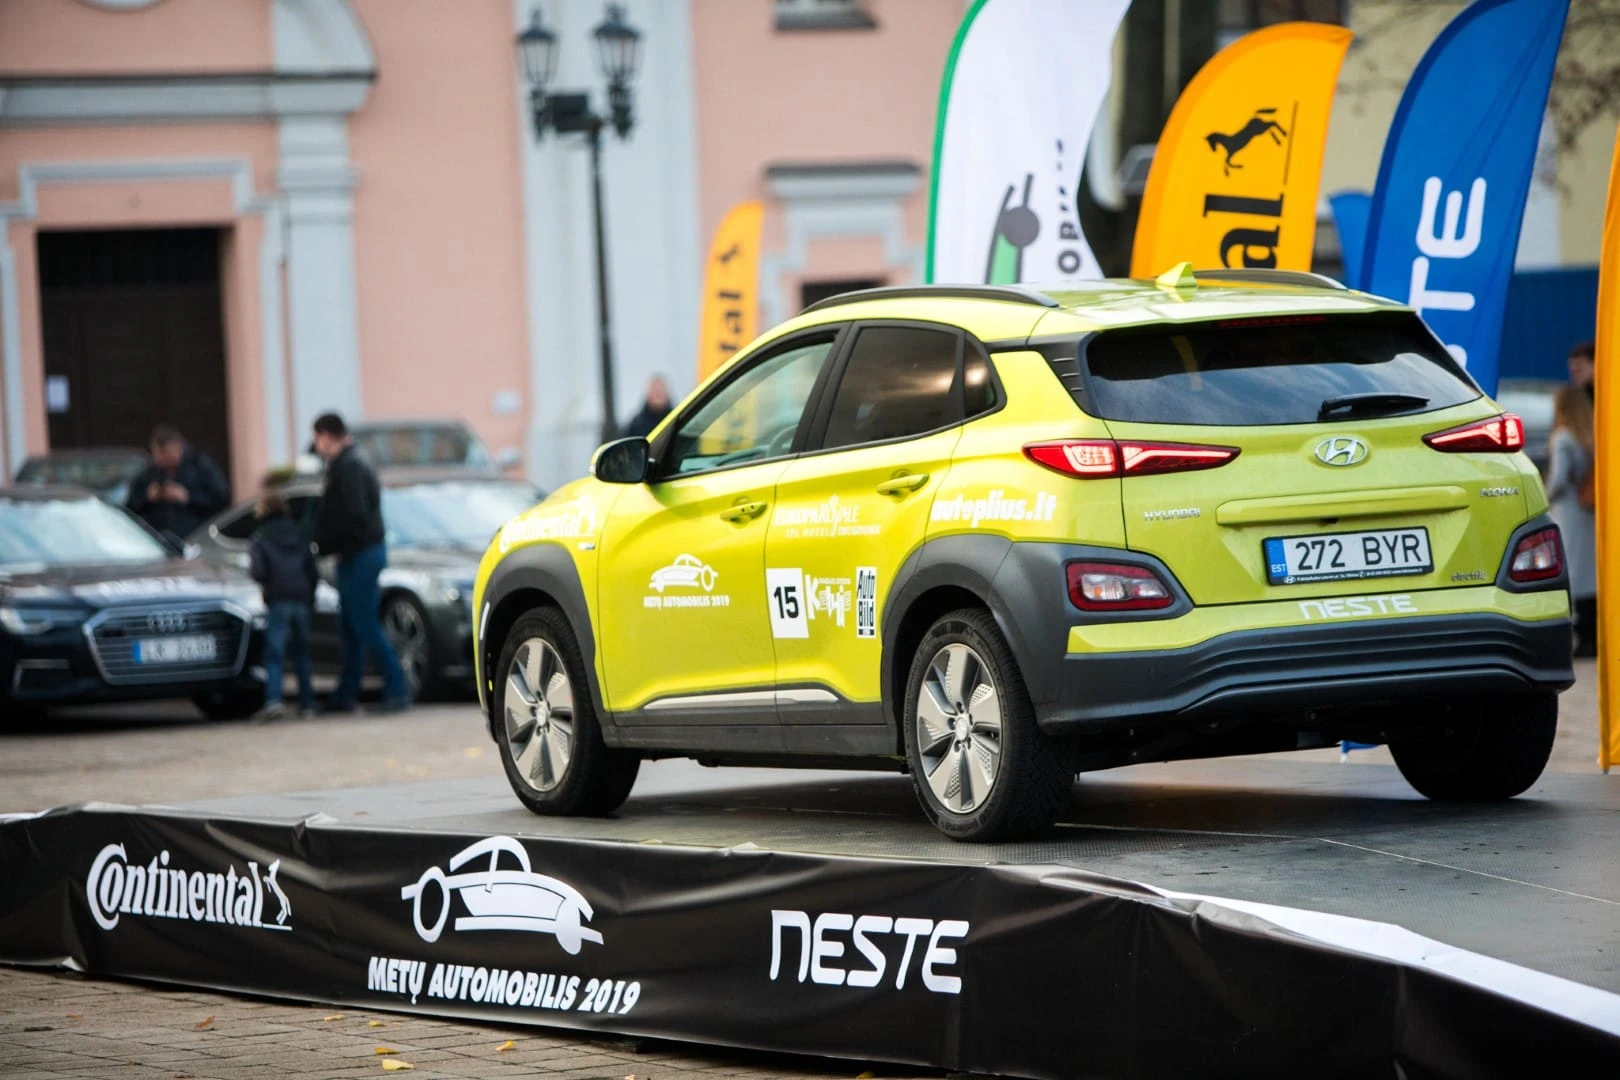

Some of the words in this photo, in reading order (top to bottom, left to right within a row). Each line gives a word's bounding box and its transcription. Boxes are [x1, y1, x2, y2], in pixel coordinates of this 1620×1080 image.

[1408, 175, 1487, 371] TE
[1144, 507, 1201, 520] HYUNDAI
[1271, 563, 1287, 573] EST
[1295, 539, 1345, 571] 272
[1361, 534, 1422, 566] BYR
[711, 594, 730, 607] 2019
[773, 585, 799, 619] 15
[1297, 594, 1419, 621] NESTE
[86, 841, 263, 930] Continental
[769, 909, 970, 994] NESTE
[367, 956, 427, 1005] METŲ
[427, 963, 581, 1011] AUTOMOBILIS
[577, 977, 641, 1015] 2019
